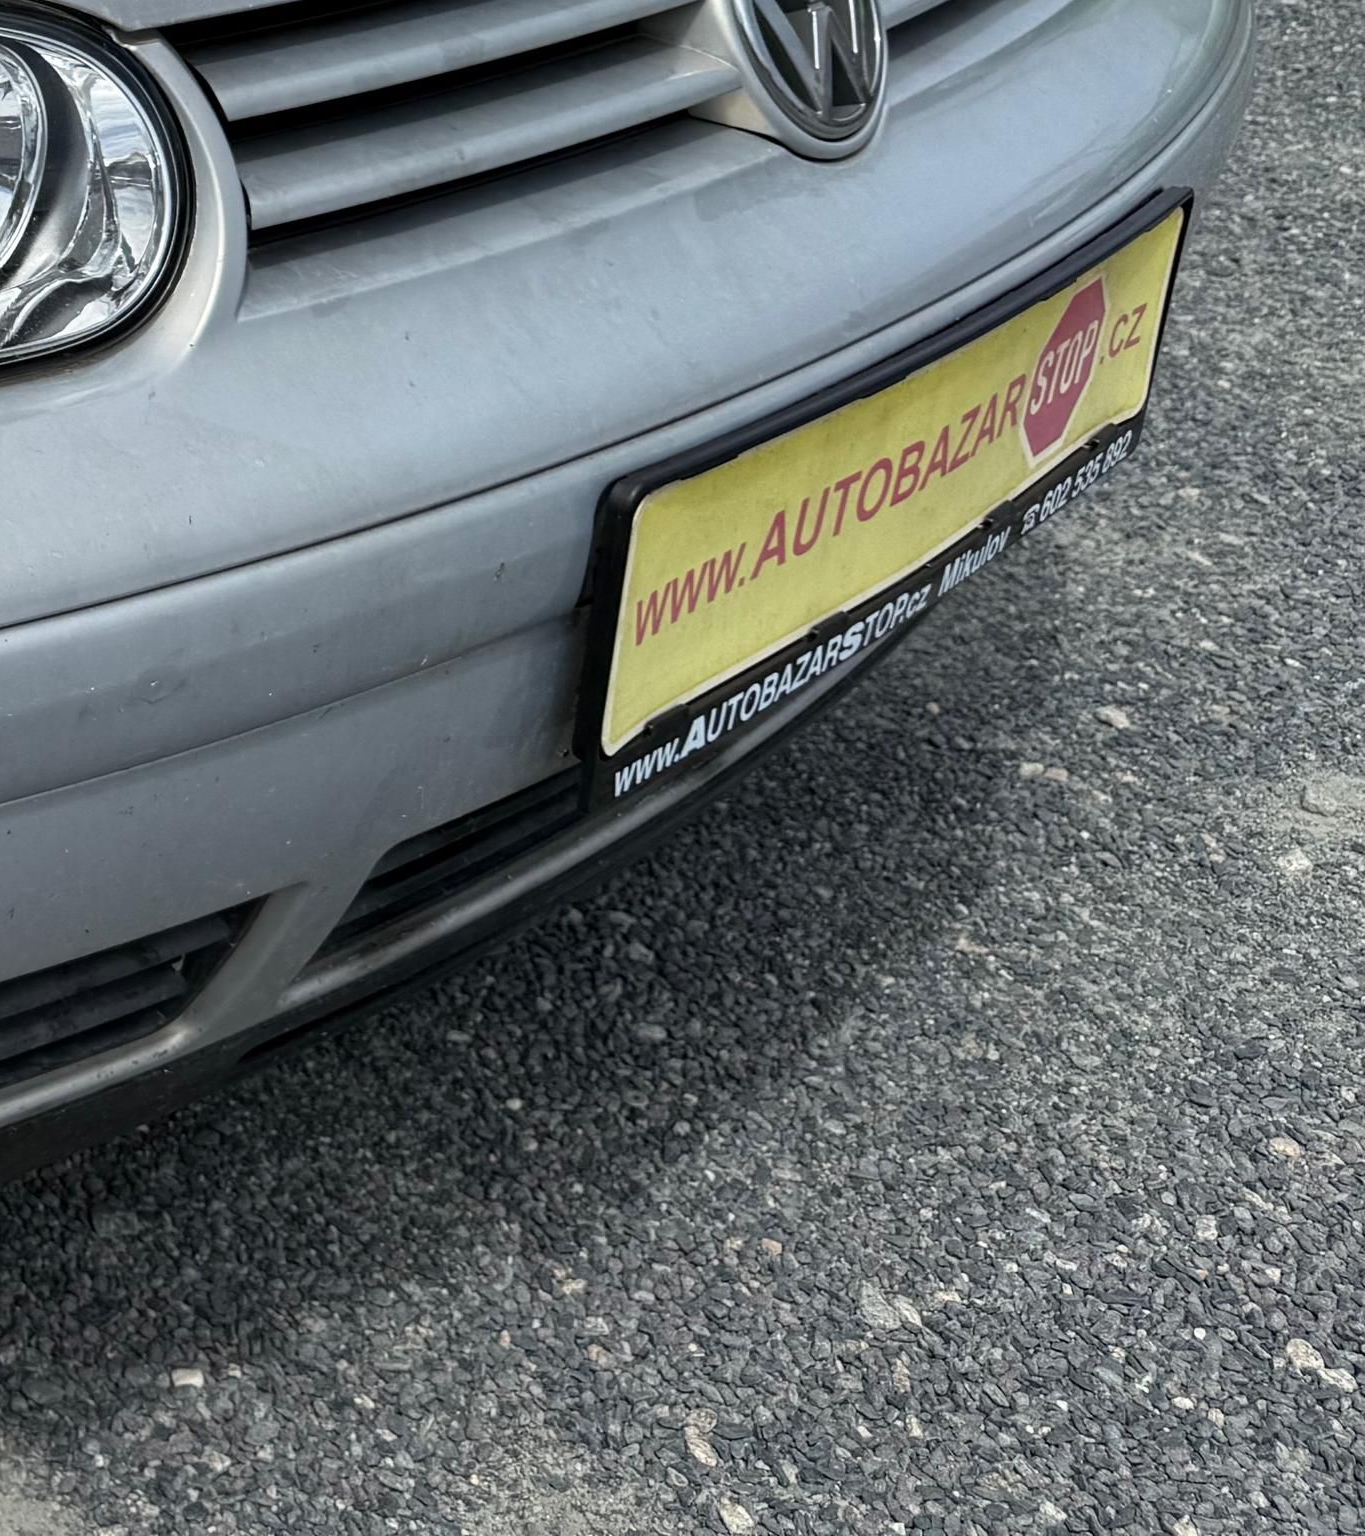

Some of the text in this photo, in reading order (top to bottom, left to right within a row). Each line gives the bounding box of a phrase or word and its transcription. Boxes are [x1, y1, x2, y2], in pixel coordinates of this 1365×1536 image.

[938, 525, 1011, 597] Mikulov
[1040, 476, 1072, 522] 602
[1072, 452, 1104, 498] 535
[1102, 429, 1132, 473] 892
